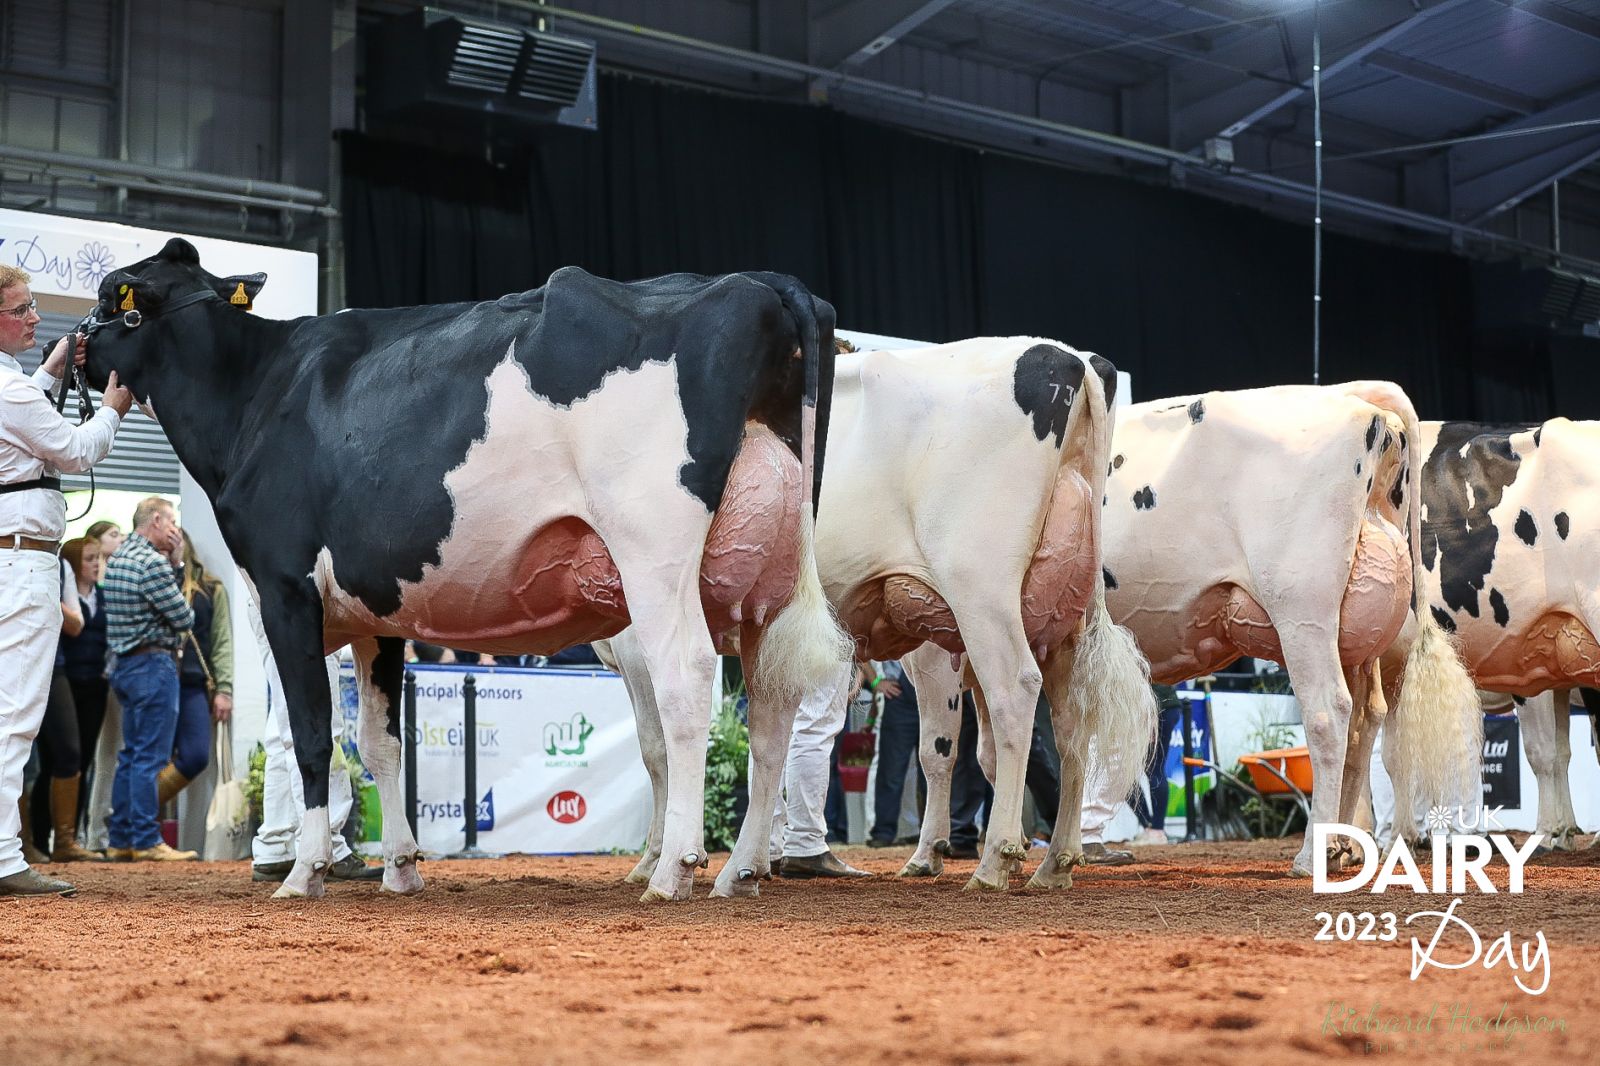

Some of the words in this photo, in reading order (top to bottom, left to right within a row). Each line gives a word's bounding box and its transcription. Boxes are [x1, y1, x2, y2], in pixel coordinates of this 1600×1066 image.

[14, 235, 72, 291] Day
[415, 683, 458, 701] ncipal
[460, 687, 522, 700] onsors
[479, 729, 499, 746] UK
[1483, 740, 1509, 757] Ltd
